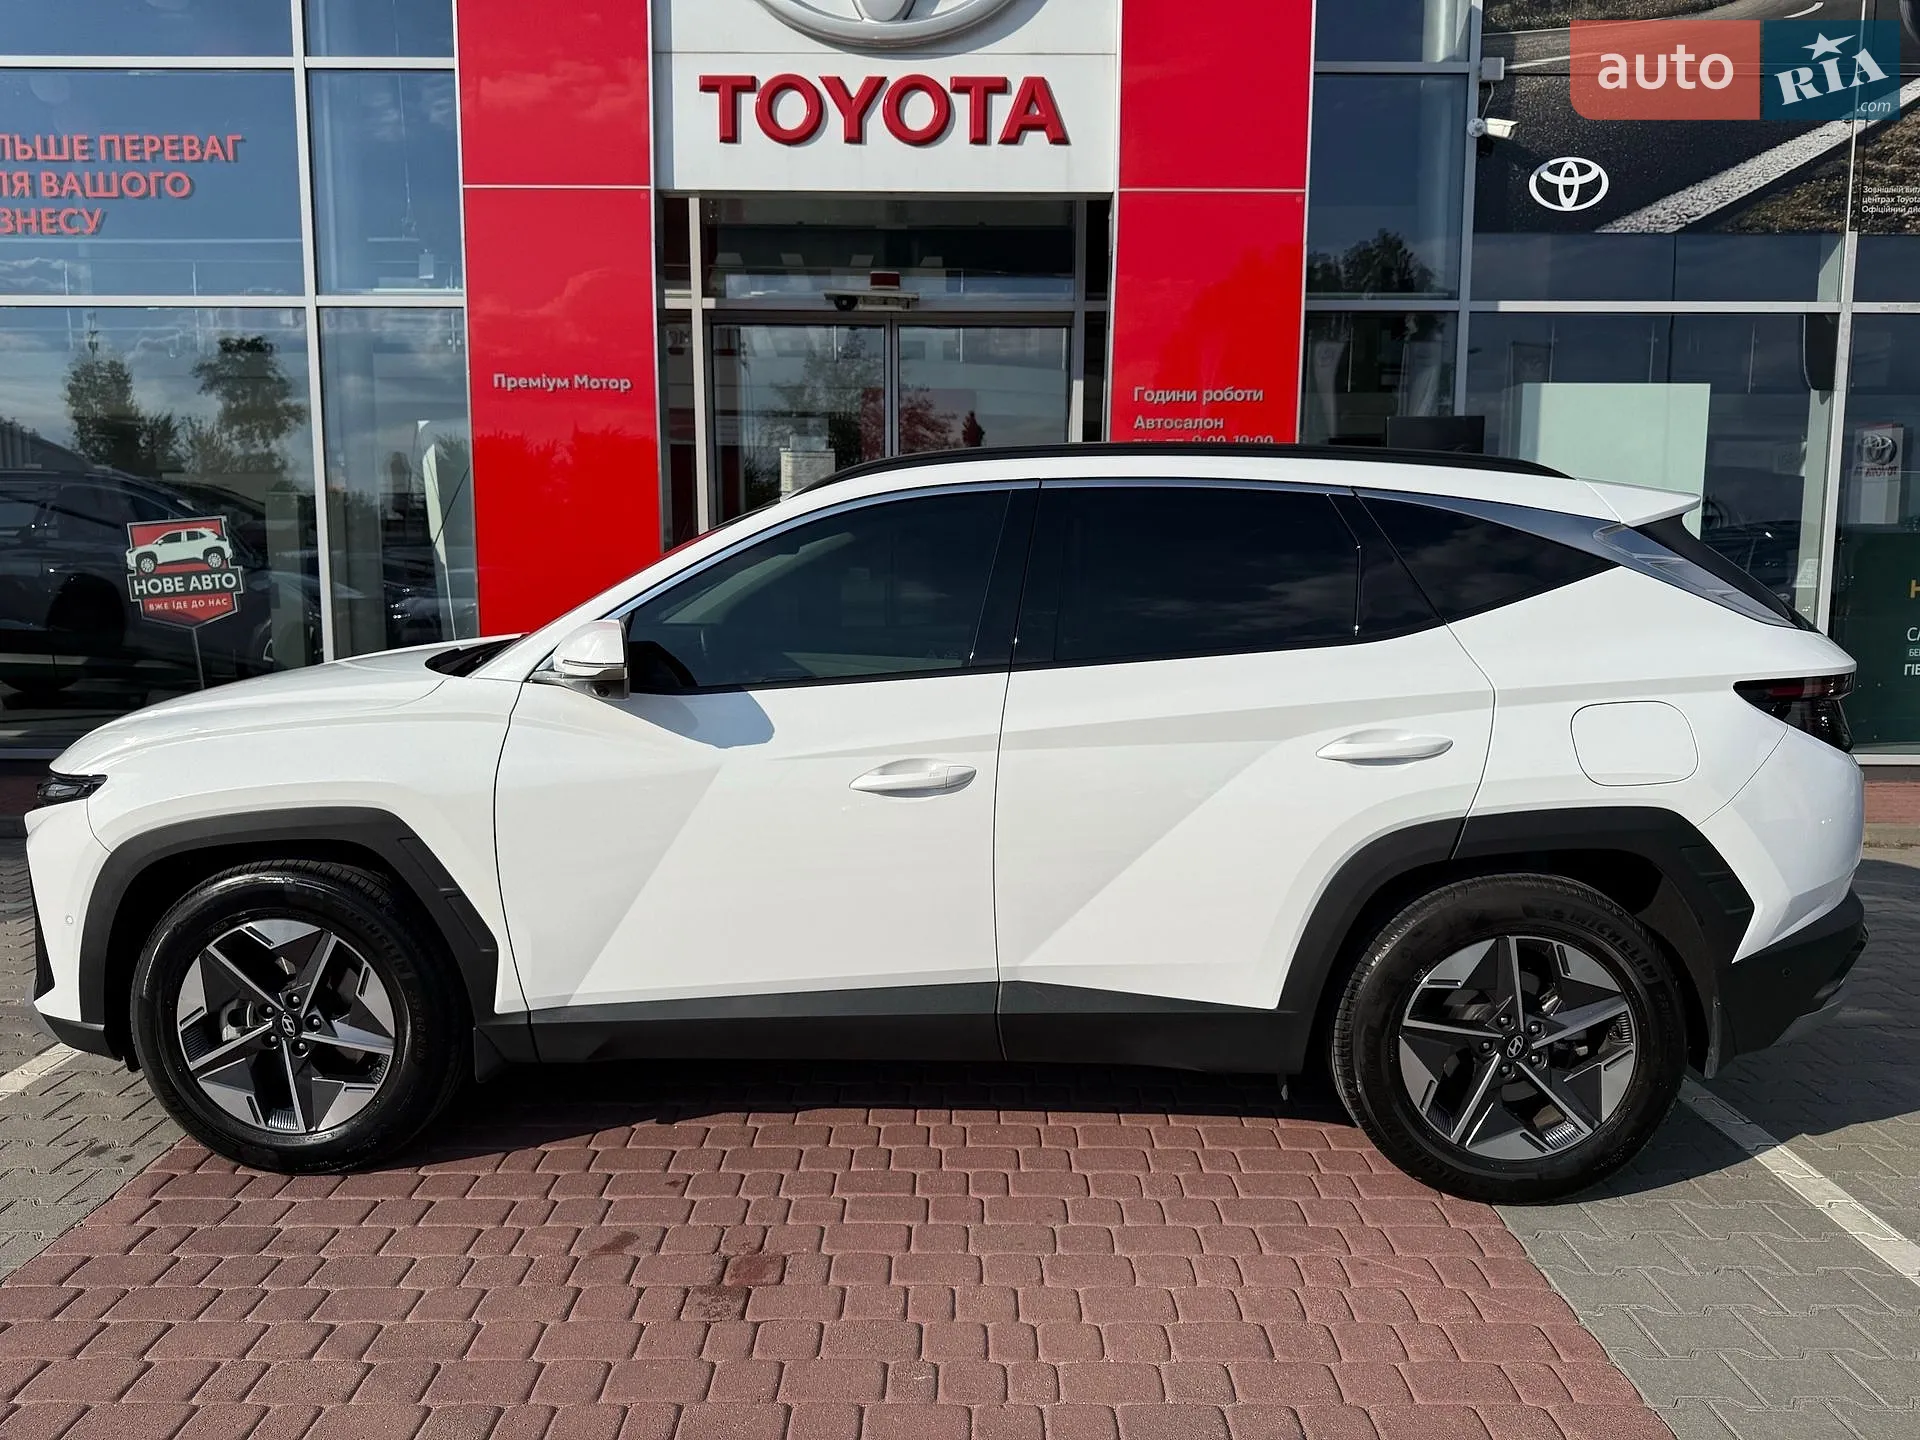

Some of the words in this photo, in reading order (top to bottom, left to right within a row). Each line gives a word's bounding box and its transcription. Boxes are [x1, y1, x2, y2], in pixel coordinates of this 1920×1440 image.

[699, 73, 1070, 146] TOYOTA
[100, 134, 242, 161] ПЕРЕВАГ
[40, 171, 191, 197] ВАШОГО
[493, 373, 569, 391] Преміум
[573, 375, 632, 393] Мотор
[1133, 387, 1196, 404] Години
[1203, 387, 1264, 405] роботи
[1133, 415, 1224, 430] Автосалон
[134, 577, 185, 595] НОВЕ
[189, 573, 236, 591] АВТО
[149, 603, 169, 612] ВЖЕ
[191, 600, 205, 609] ДО
[208, 598, 228, 608] НАС
